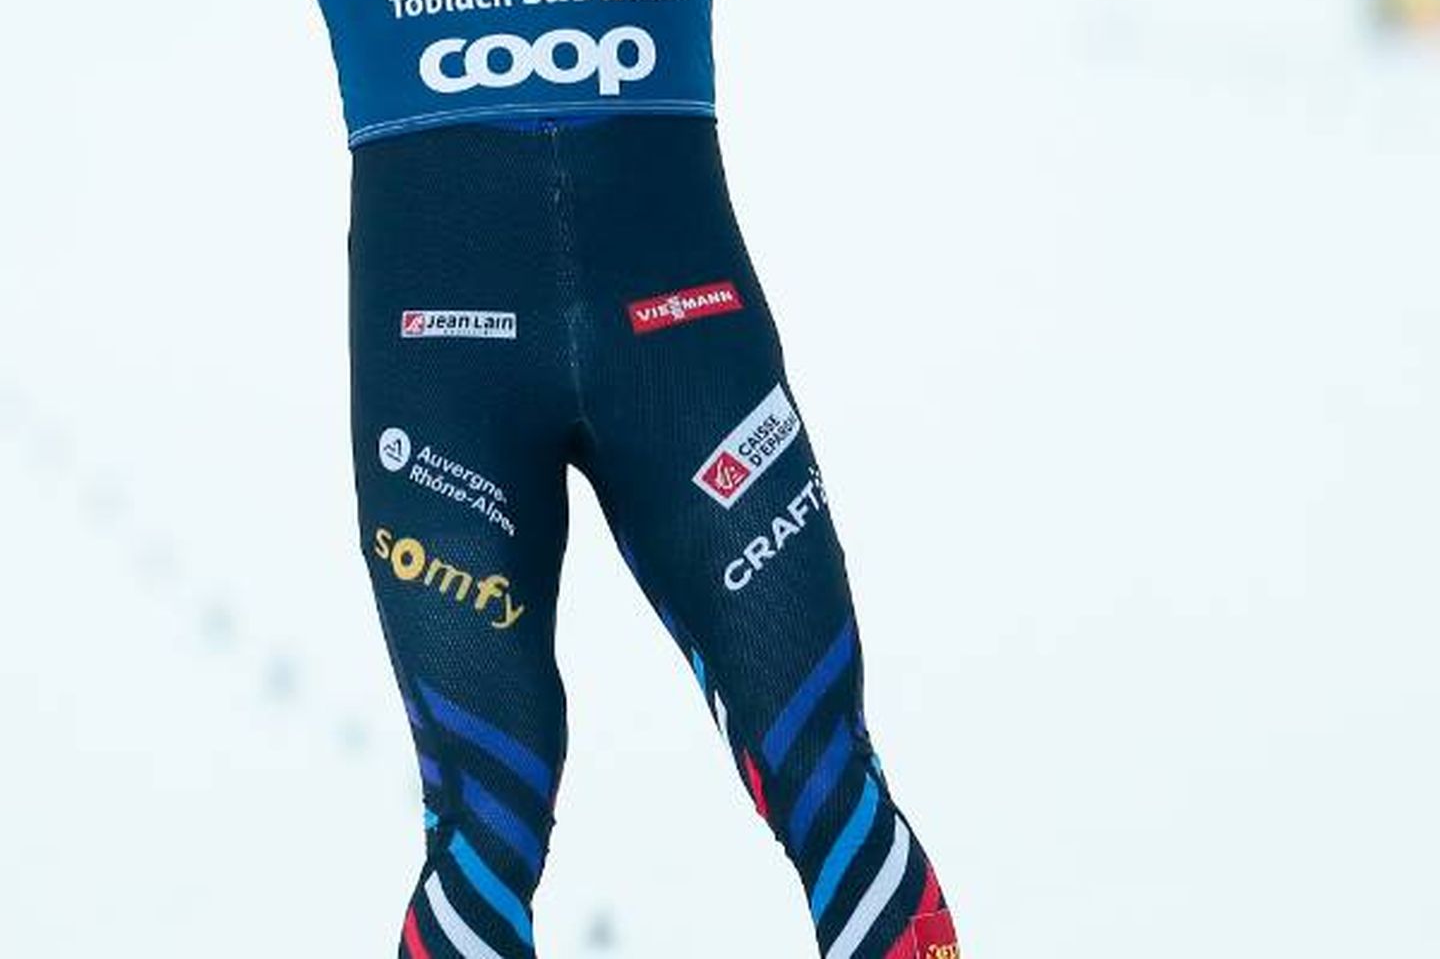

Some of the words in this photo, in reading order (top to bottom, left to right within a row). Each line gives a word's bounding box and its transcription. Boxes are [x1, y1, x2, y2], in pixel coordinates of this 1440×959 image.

[418, 25, 657, 96] coop
[426, 315, 470, 330] Jean
[635, 290, 734, 322] VIESSMANN
[739, 414, 781, 457] CAISSE
[723, 478, 821, 592] CRAFT
[374, 527, 526, 629] somfy
